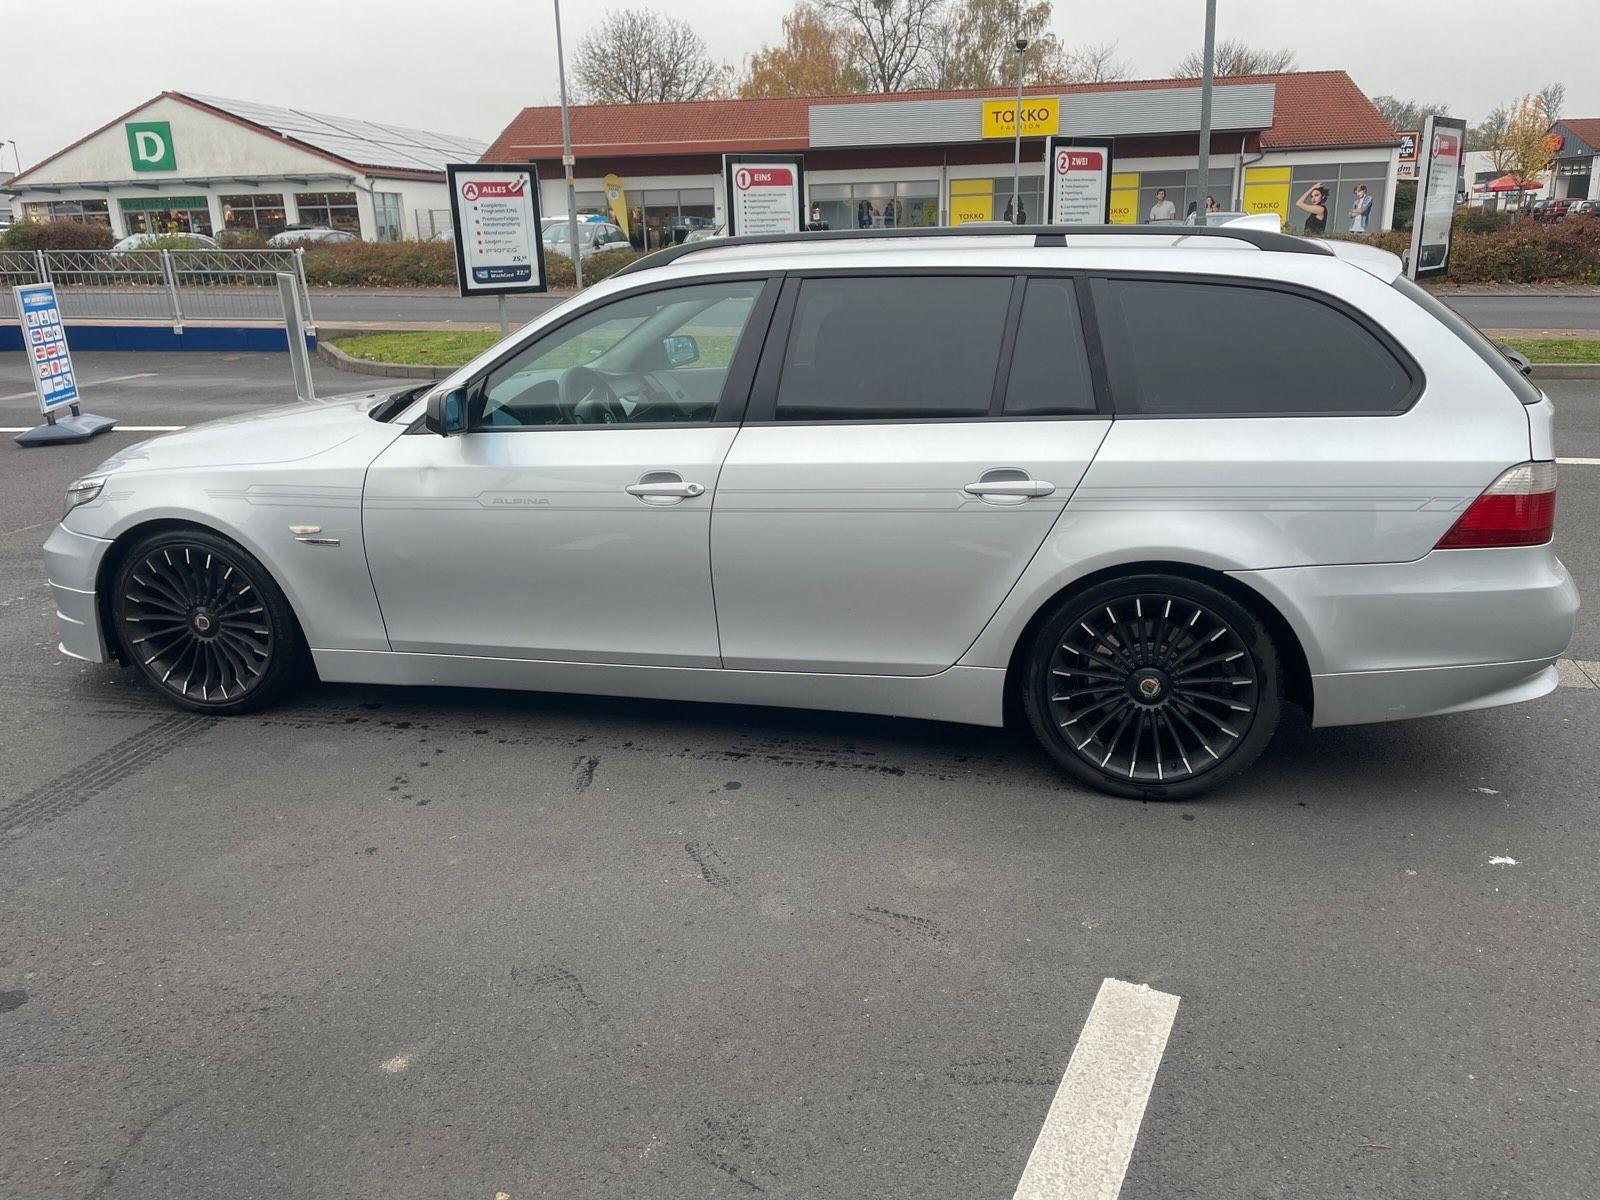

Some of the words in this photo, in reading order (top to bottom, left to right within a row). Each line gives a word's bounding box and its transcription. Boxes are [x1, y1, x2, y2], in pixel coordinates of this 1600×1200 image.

[135, 131, 165, 163] D
[1060, 157, 1067, 169] 2
[1071, 157, 1088, 165] ZWEI
[740, 173, 746, 186] 1
[754, 173, 772, 181] EINS
[465, 184, 476, 195] A
[481, 186, 506, 194] ALLES
